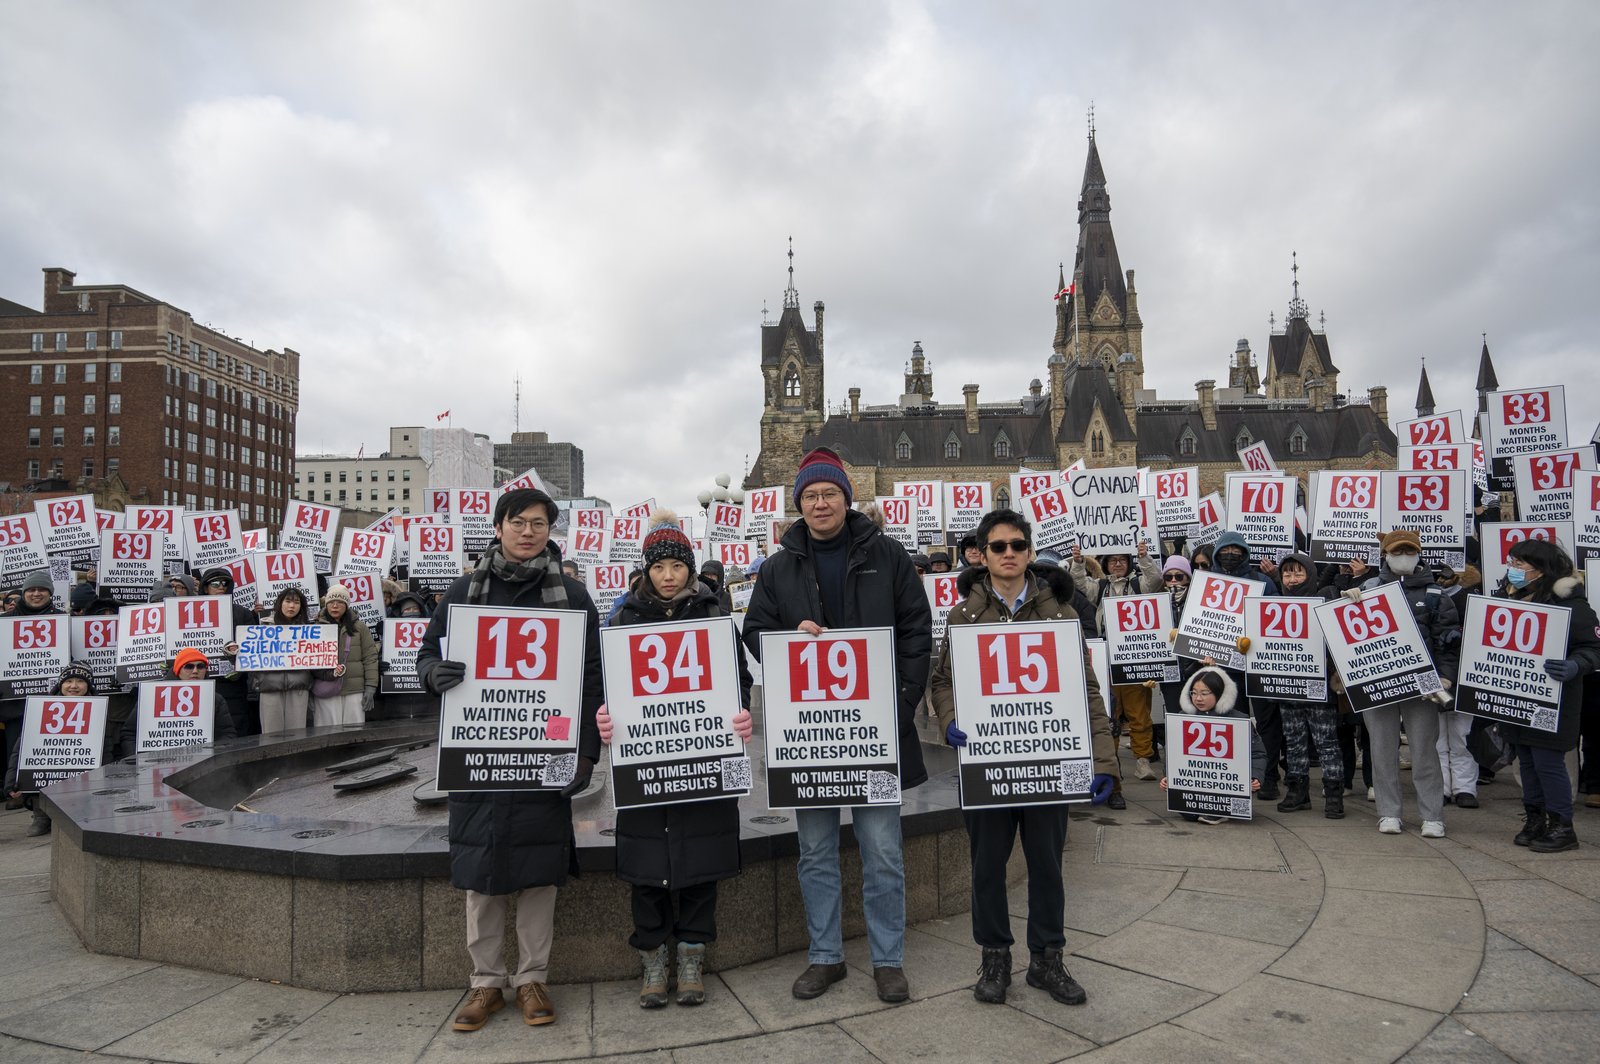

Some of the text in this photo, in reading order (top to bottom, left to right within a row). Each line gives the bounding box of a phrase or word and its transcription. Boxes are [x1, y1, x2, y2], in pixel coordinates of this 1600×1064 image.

[1509, 392, 1546, 424] 33
[1414, 420, 1447, 445] 22
[1501, 434, 1557, 444] WAITING FOR
[1509, 426, 1546, 435] MONTHS
[1417, 450, 1453, 470] 35
[1536, 455, 1574, 489] 37
[1072, 476, 1139, 497] CANADA
[1160, 473, 1185, 499] 36
[1335, 476, 1372, 508] 68
[1404, 477, 1444, 510] 53
[462, 491, 486, 513] 25
[755, 492, 774, 513] 27
[957, 486, 979, 508] 32
[1036, 492, 1062, 520] 13
[1248, 483, 1278, 513] 70
[53, 501, 81, 526] 62
[141, 511, 169, 530] 22
[300, 507, 323, 530] 31
[582, 511, 600, 528] 39
[718, 506, 738, 526] 16
[885, 501, 906, 524] 30
[1074, 506, 1136, 526] WHAT ARE
[1333, 511, 1368, 519] MONTHS
[54, 526, 83, 534] MONTHS
[199, 516, 227, 541] 43
[617, 520, 637, 539] 34
[1041, 517, 1067, 530] MONTHS
[1323, 521, 1377, 529] WAITING FOR
[354, 534, 381, 558] 39
[423, 527, 451, 552] 39
[580, 531, 599, 551] 72
[1100, 525, 1139, 547] DOING?
[117, 534, 147, 559] 39
[724, 545, 746, 565] 16
[271, 555, 300, 579] 40
[599, 567, 623, 589] 30
[1206, 579, 1243, 612] 30
[134, 609, 161, 635] 19
[184, 602, 214, 629] 11
[1121, 600, 1156, 631] 30
[1265, 603, 1303, 637] 20
[1343, 600, 1390, 641] 65
[18, 621, 52, 648] 53
[246, 626, 320, 640] STOP THE
[399, 623, 426, 647] 39
[1489, 608, 1539, 653] 90
[487, 618, 547, 679] 13
[1265, 642, 1303, 651] MONTHS
[1354, 637, 1397, 655] MONTHS
[639, 631, 704, 694] 34
[989, 634, 1048, 694] 15
[1257, 652, 1313, 662] WAITING FOR
[1348, 644, 1413, 669] WAITING FOR
[1487, 652, 1535, 669] MONTHS
[800, 641, 856, 700] 19
[1251, 662, 1319, 673] IRCC RESPONSE
[1346, 654, 1424, 682] IRCC RESPONSE
[1474, 662, 1547, 684] WAITING FOR
[1363, 683, 1375, 694] NO
[1466, 673, 1552, 697] IRCC RESPONSE
[160, 686, 194, 717] 18
[481, 689, 546, 703] MONTHS
[1370, 691, 1382, 701] NO
[1475, 691, 1488, 701] NO
[463, 708, 528, 722] WAITING
[643, 700, 705, 718] MONTHS
[799, 709, 861, 724] MONTHS
[991, 701, 1053, 717] MONTHS
[1478, 702, 1491, 712] NO
[46, 702, 86, 734] 34
[158, 720, 194, 729] MONTHS
[628, 717, 723, 738] WAITING FOR
[976, 719, 1070, 737] WAITING FOR
[43, 738, 82, 746] MONTHS
[149, 730, 185, 738] WAITING
[452, 726, 486, 740] IRCC
[784, 726, 878, 742] WAITING FOR
[1188, 722, 1227, 758] 25
[33, 748, 91, 756] WAITING FOR
[620, 733, 734, 757] IRCC RESPONSE
[776, 744, 888, 760] IRCC RESPONSE
[969, 737, 1081, 756] IRCC RESPONSE
[25, 758, 95, 766] IRCC RESPONSE
[466, 754, 551, 765] NO TIMELINES
[1188, 760, 1228, 770] MONTHS
[470, 769, 488, 781] NO
[637, 761, 721, 781] NO TIMELINES
[792, 772, 808, 784] NO
[985, 764, 1061, 780] NO TIMELINE
[1179, 768, 1239, 781] WAITING FOR
[644, 777, 717, 795] NO RESULTS
[798, 785, 868, 798] NO RESULTS
[992, 783, 1009, 795] NO
[1173, 778, 1244, 792] IRCC RESPONSE
[1196, 793, 1232, 803] TIMELINE
